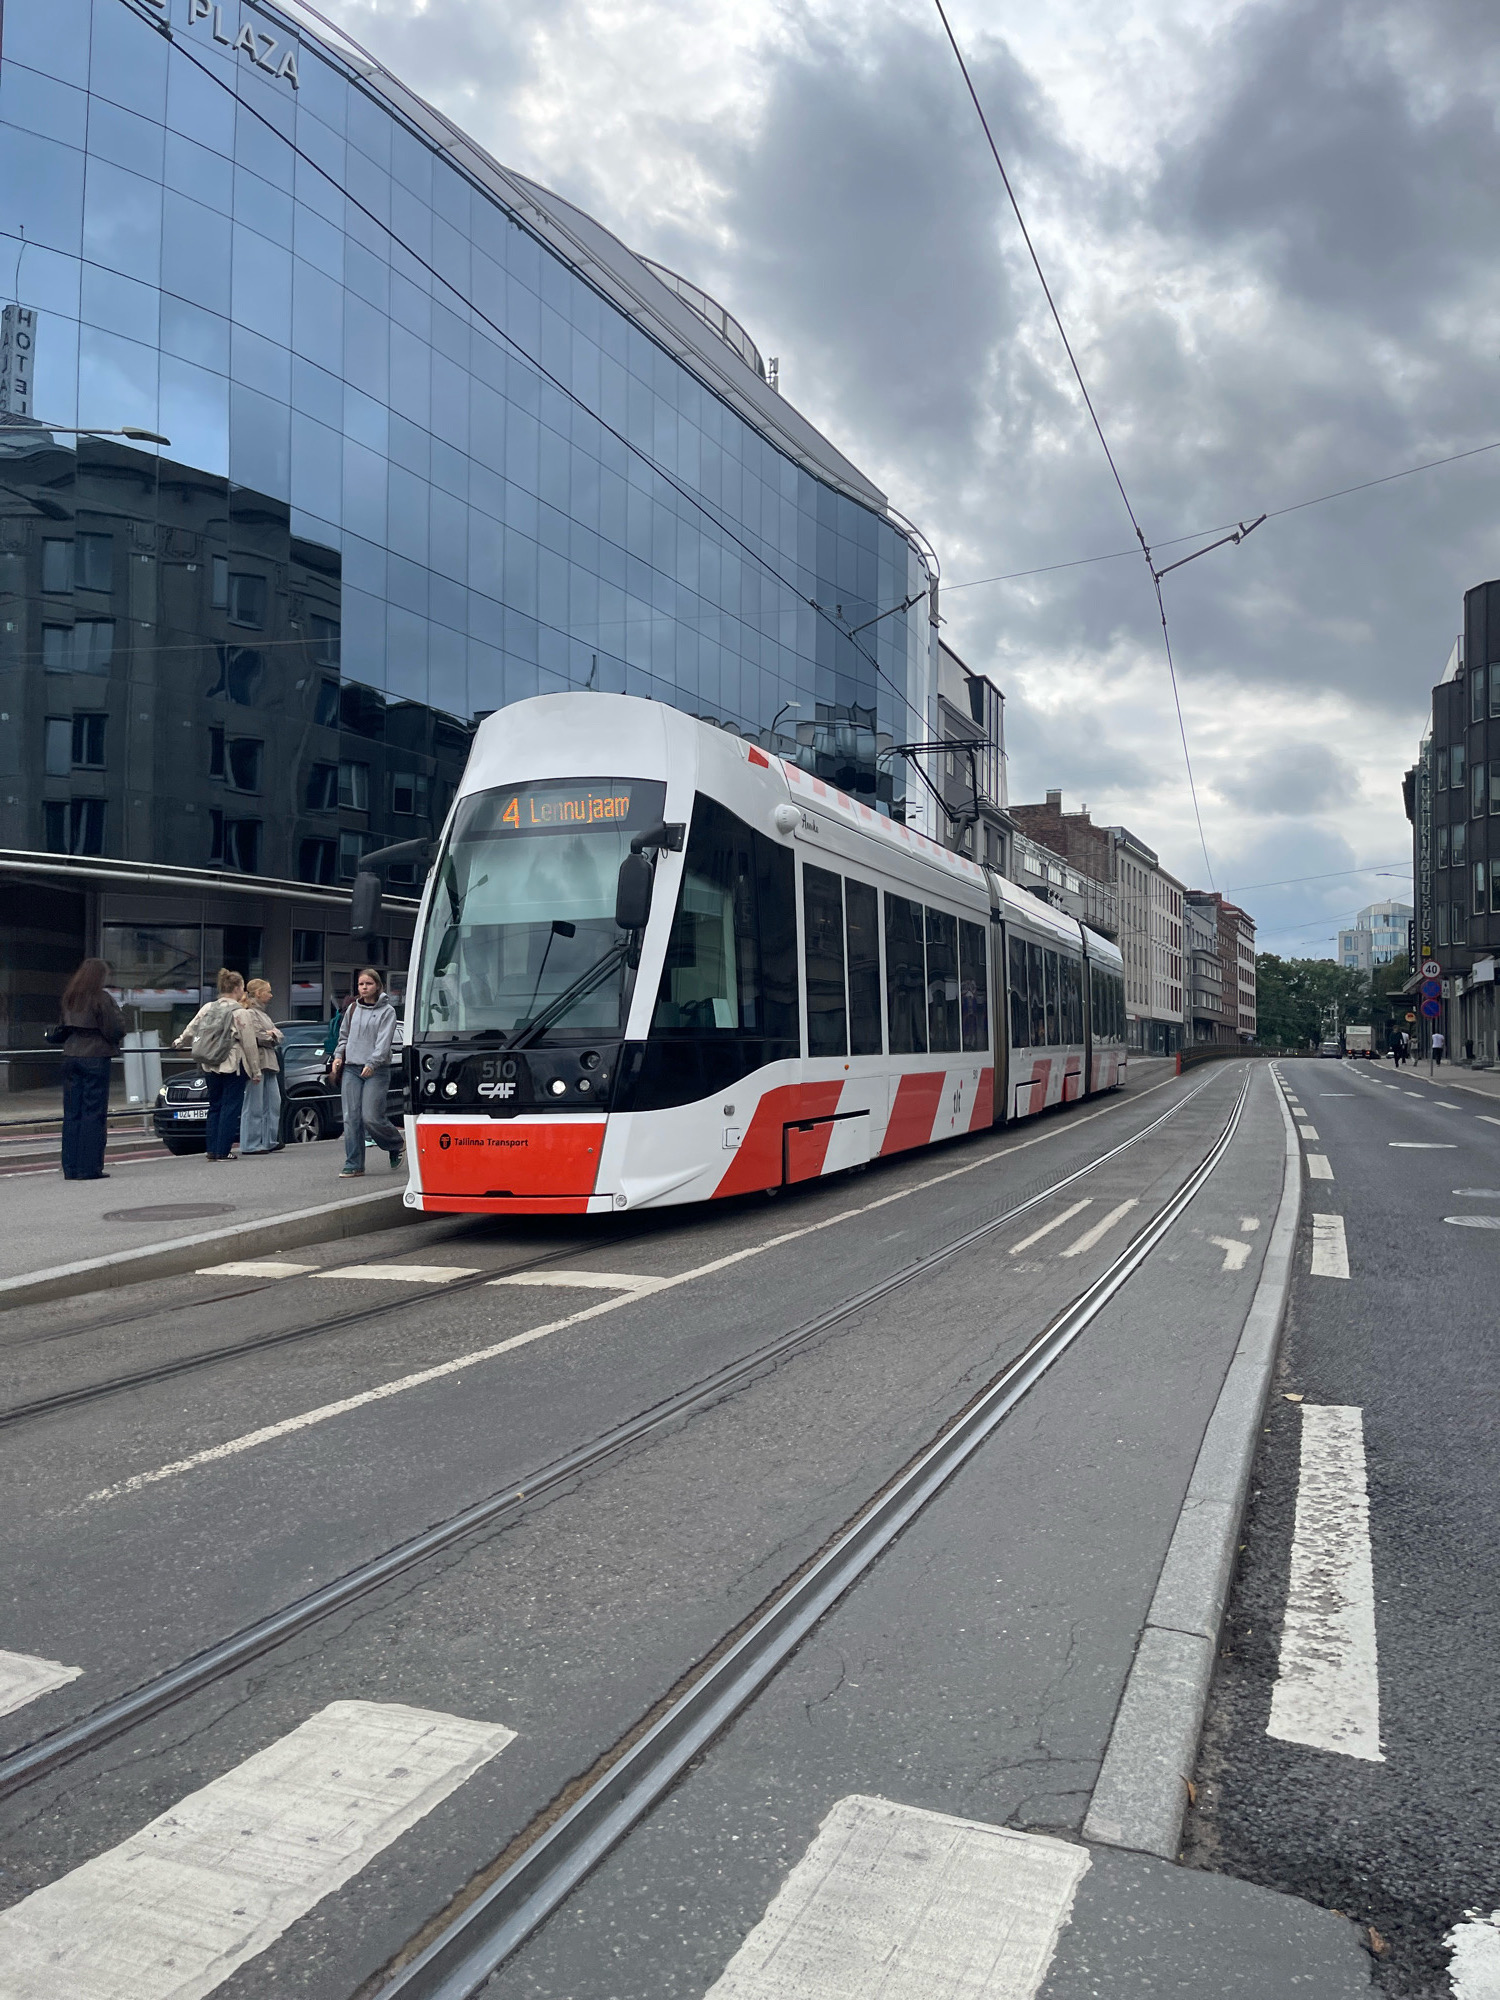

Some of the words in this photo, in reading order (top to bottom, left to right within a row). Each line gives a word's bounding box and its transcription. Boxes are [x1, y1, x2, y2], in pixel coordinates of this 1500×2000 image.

[188, 0, 299, 90] PLAZA
[503, 798, 520, 828] 4
[530, 794, 630, 823] Lennujaam
[1425, 965, 1438, 974] 40
[482, 1060, 517, 1079] 510
[477, 1082, 516, 1099] CAF
[454, 1137, 485, 1146] Tallinna
[487, 1138, 529, 1148] Transport
